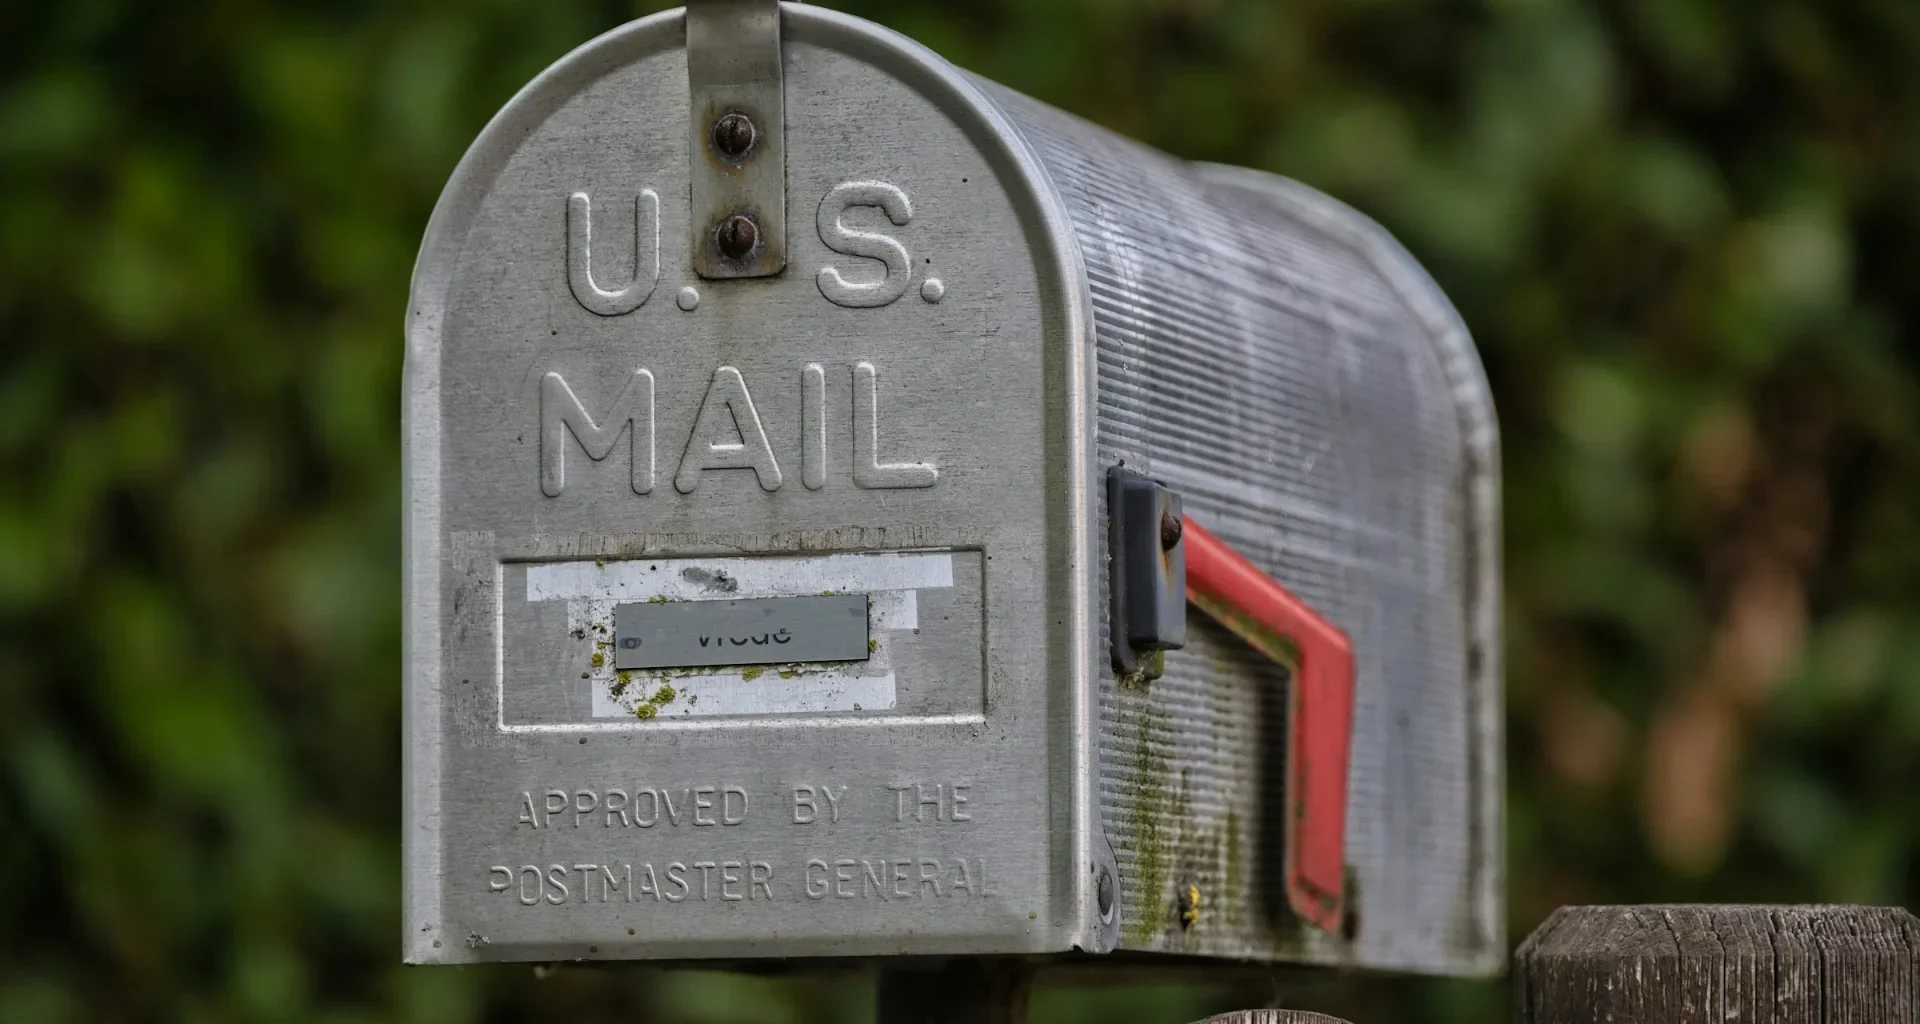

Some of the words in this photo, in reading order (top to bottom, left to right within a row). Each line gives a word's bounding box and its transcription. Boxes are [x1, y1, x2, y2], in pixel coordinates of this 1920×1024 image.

[540, 361, 939, 497] MAIL
[517, 784, 748, 829] APPROVED
[792, 785, 847, 825] BY
[887, 784, 972, 823] THE
[488, 862, 774, 906] POSTMASTER
[804, 858, 998, 900] GENERAL
